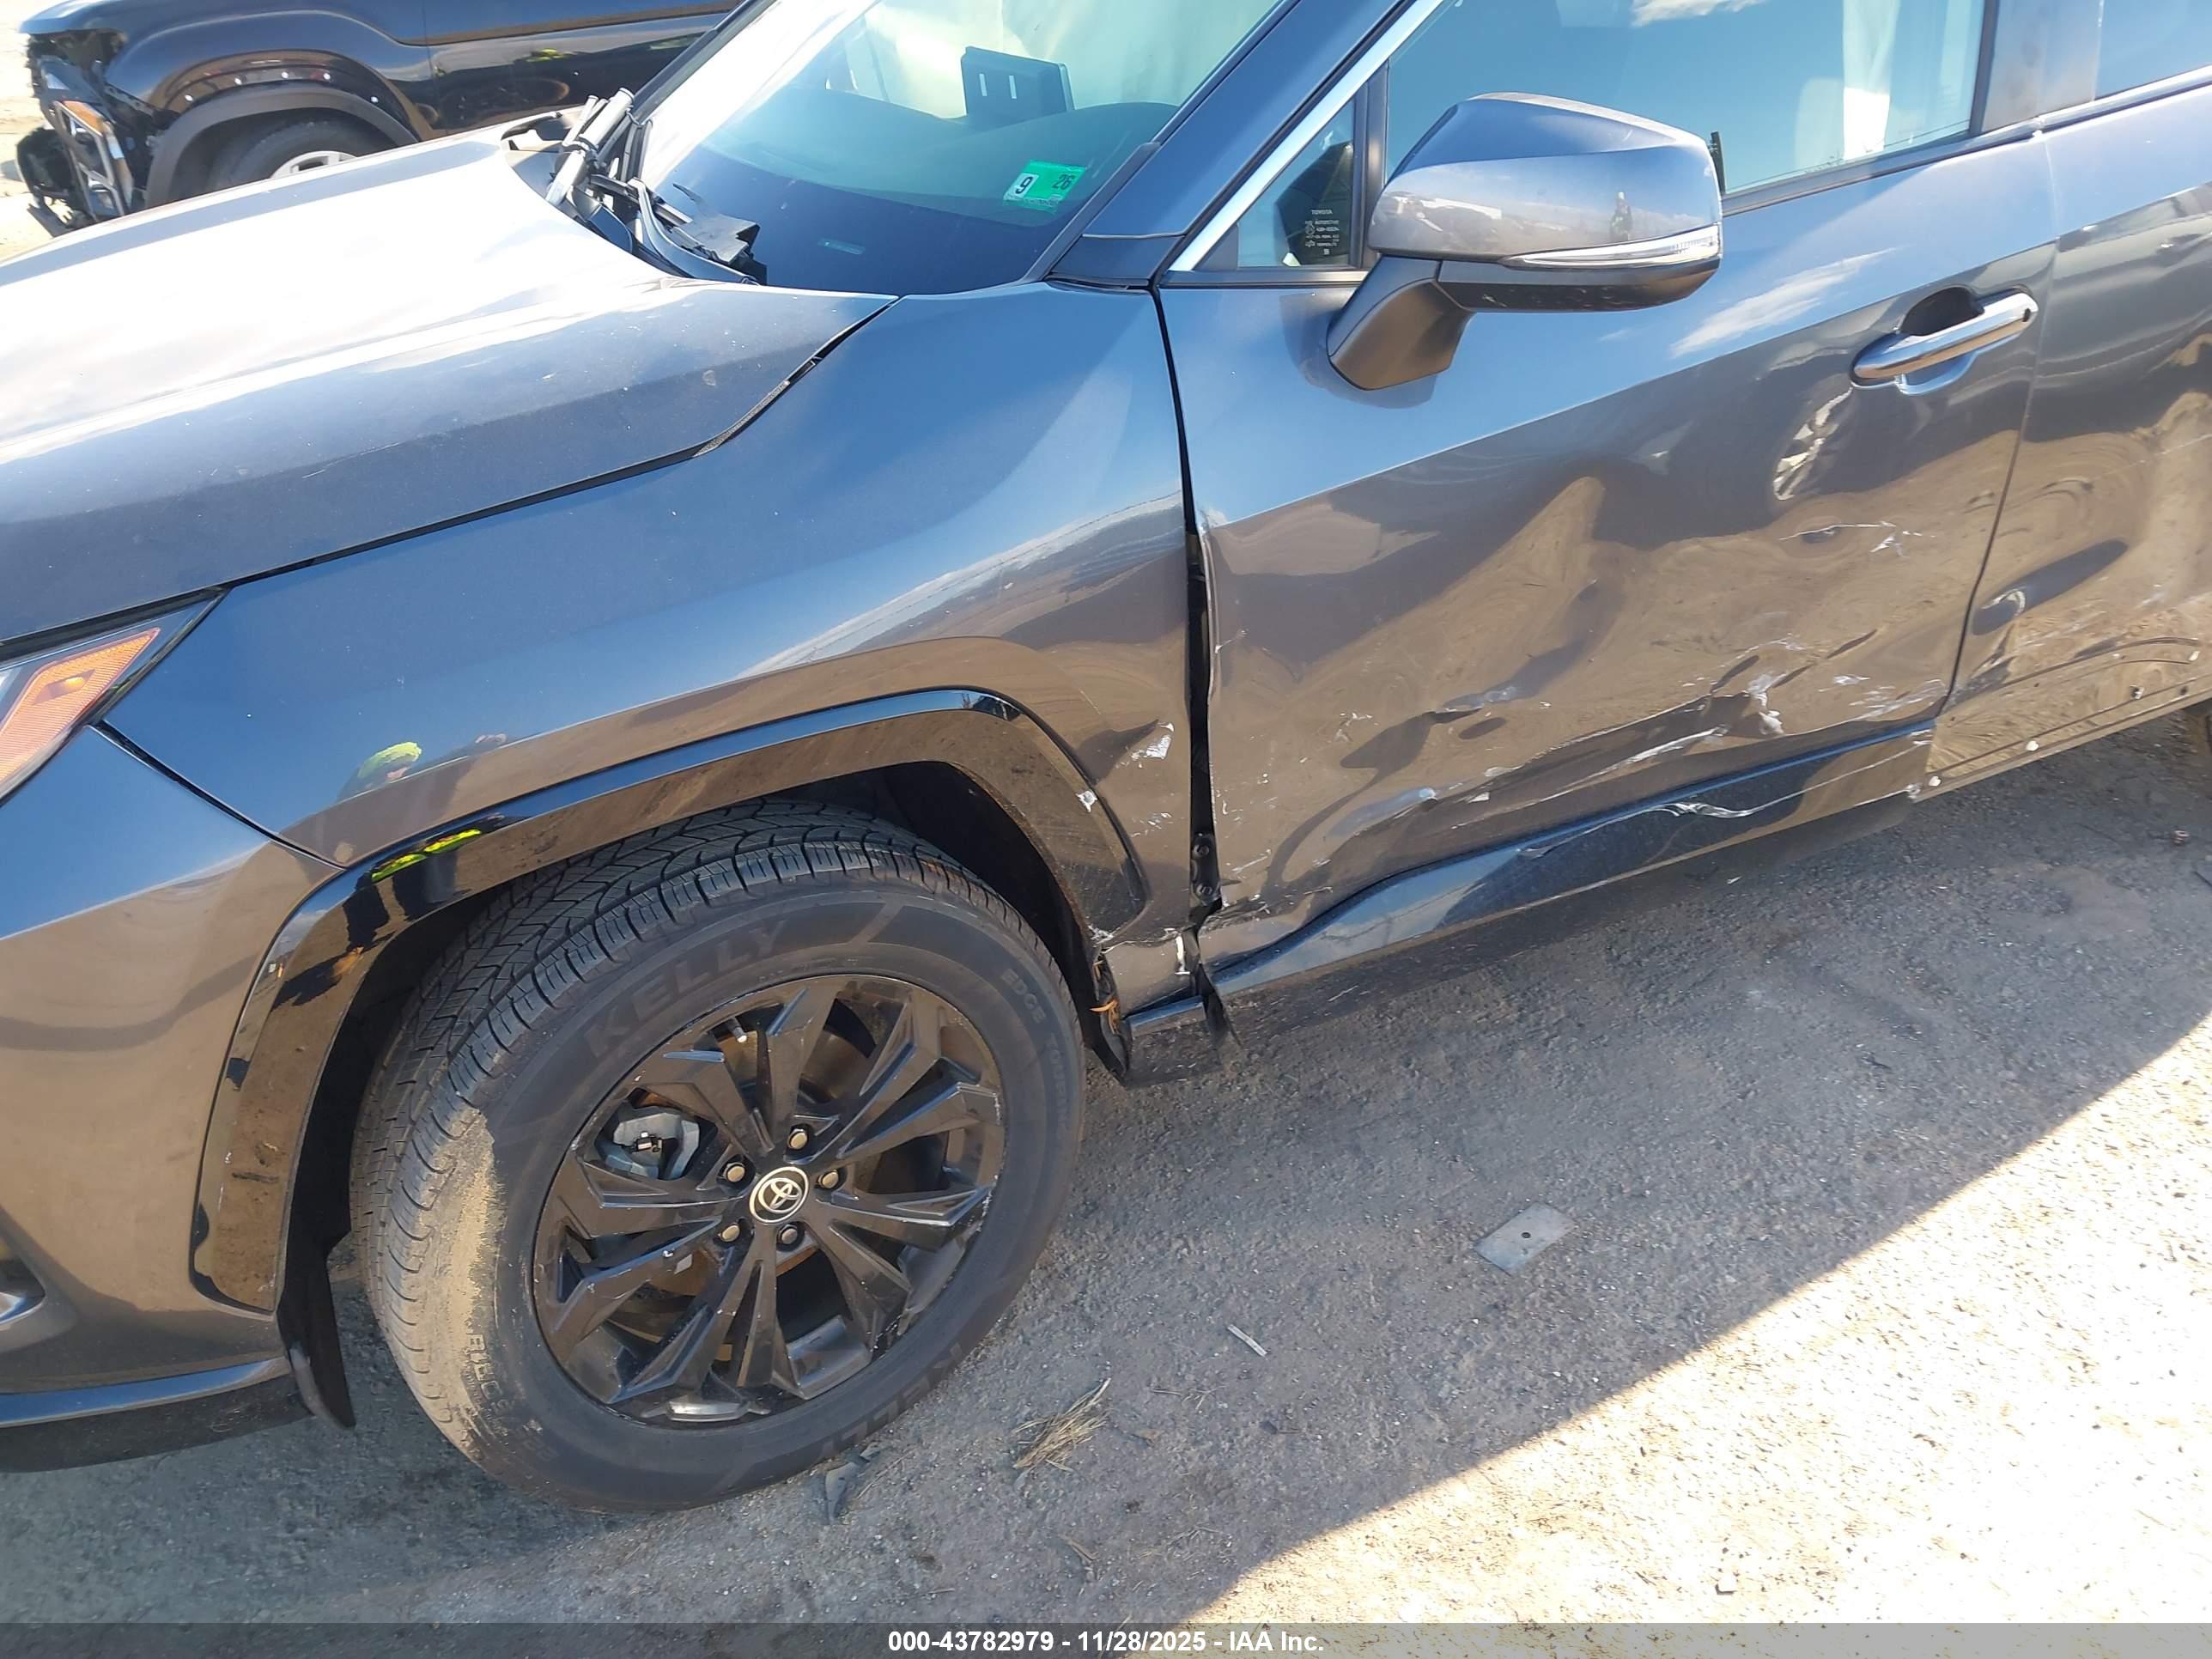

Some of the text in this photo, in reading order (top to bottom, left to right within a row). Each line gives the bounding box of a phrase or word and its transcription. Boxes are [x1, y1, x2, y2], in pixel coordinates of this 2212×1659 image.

[1015, 173, 1076, 195] 9 26
[584, 919, 789, 1058] KELLY
[1000, 968, 1047, 1024] EDGE
